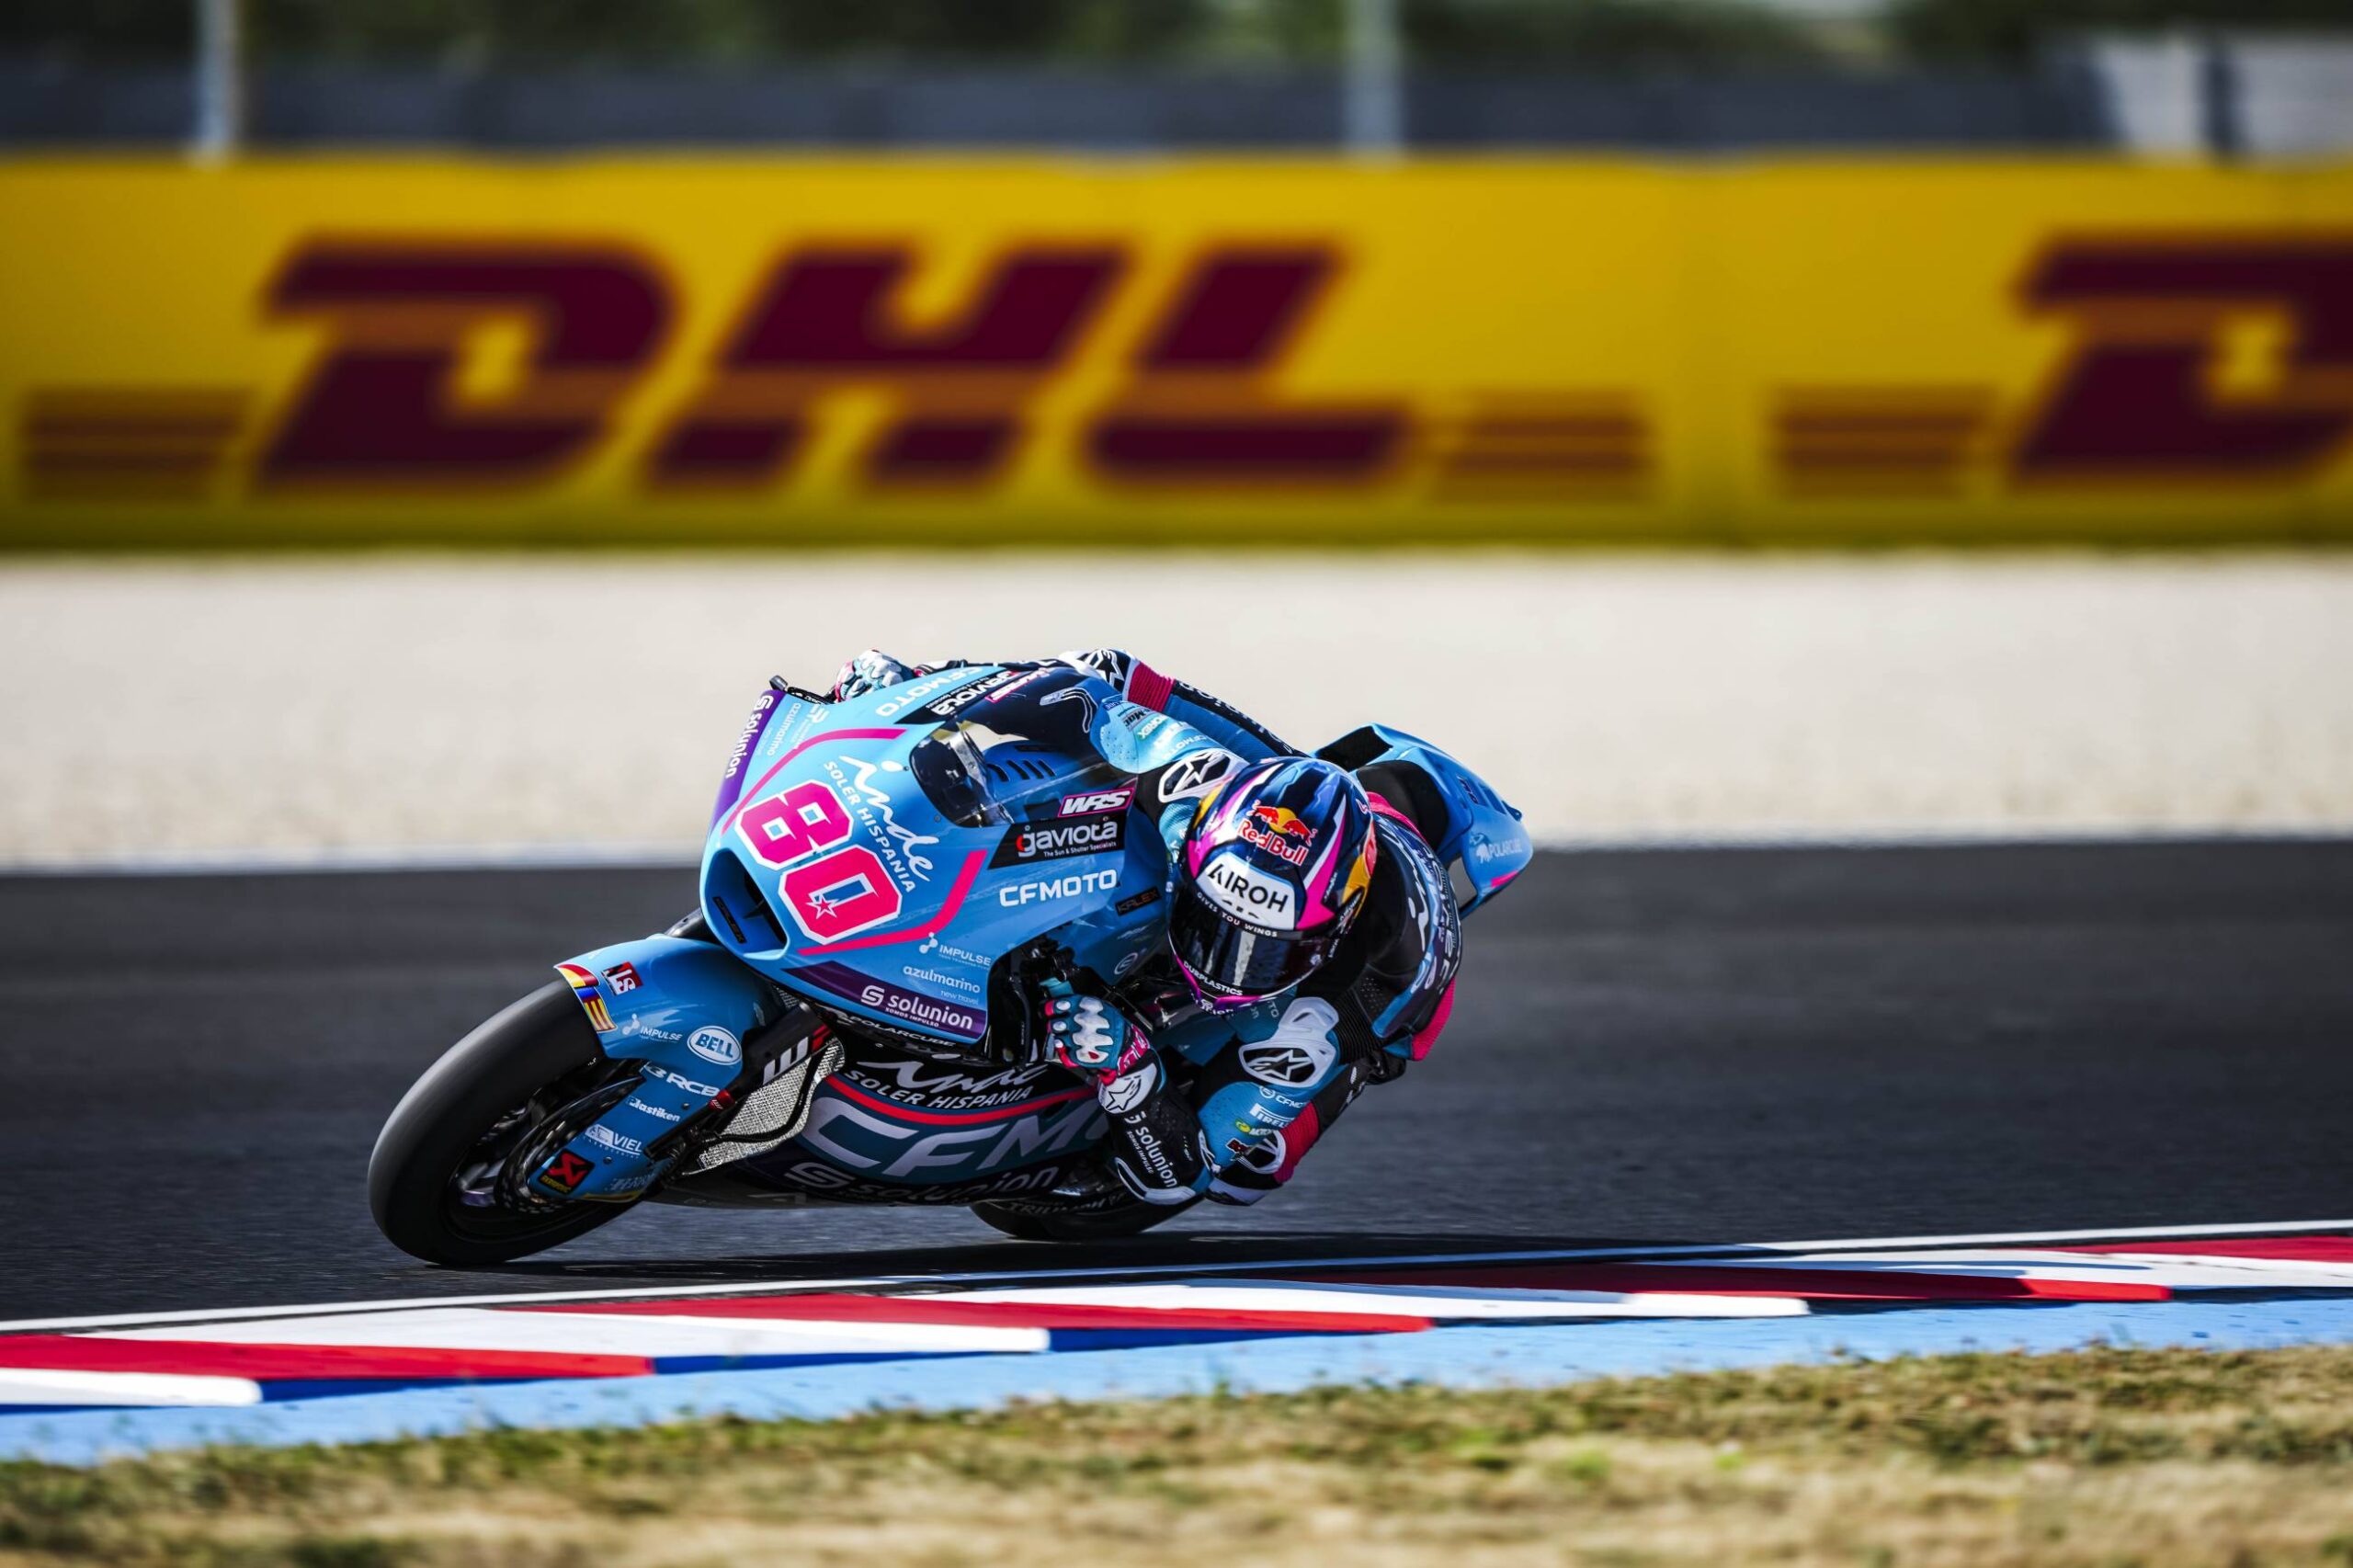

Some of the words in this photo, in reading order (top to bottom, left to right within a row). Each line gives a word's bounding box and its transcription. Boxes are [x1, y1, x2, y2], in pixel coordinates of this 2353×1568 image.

[258, 239, 1406, 483] DHL
[875, 666, 983, 717] CFMOTO
[725, 713, 762, 778] solunion
[1062, 790, 1131, 814] WRS
[824, 761, 861, 806] SOLER
[857, 807, 915, 892] HISPANIA
[1016, 817, 1118, 858] gaviota
[735, 779, 904, 946] 80
[1054, 848, 1065, 858] Sun
[1070, 846, 1089, 855] Shutter
[1090, 841, 1117, 851] Specialists
[999, 869, 1118, 907] CFMOTO
[1207, 864, 1289, 913] AIROH
[1197, 892, 1218, 913] GIVES
[1222, 911, 1241, 926] YOU
[1245, 923, 1278, 937] WINGS
[939, 945, 992, 966] IMPULSE
[903, 966, 981, 994] azulmarino
[940, 991, 956, 1000] new
[958, 994, 979, 1006] travel
[886, 995, 973, 1029] solunion
[640, 1027, 683, 1040] IMPULSE
[695, 1033, 733, 1059] BELL
[849, 1016, 957, 1047] POLARCUBE
[844, 1069, 926, 1106] SOLER
[926, 1085, 1034, 1109] HISPANIA
[613, 1133, 642, 1153] VIEL
[1135, 1126, 1178, 1187] solunion
